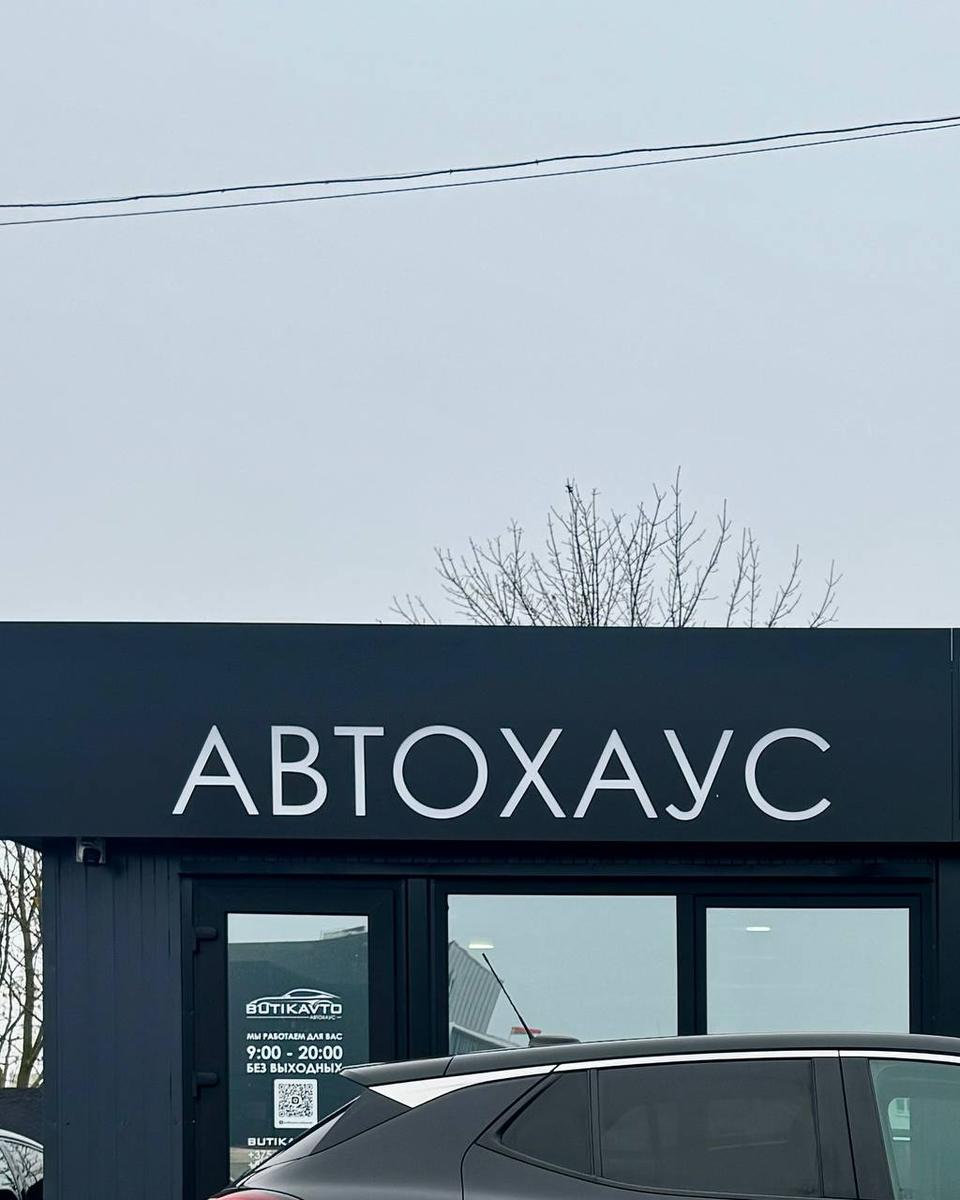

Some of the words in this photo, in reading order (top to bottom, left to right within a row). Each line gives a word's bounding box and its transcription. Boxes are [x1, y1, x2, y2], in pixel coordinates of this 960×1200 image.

[171, 725, 832, 822] АВТОХАУС
[246, 1003, 343, 1015] BUTIKAVTO
[246, 1033, 261, 1041] МЫ
[263, 1033, 306, 1041] РАБОТАЕМ
[307, 1033, 324, 1041] ДЛЯ
[326, 1033, 343, 1041] ВАС
[246, 1045, 282, 1060] 9:00
[298, 1045, 343, 1060] 20:00
[246, 1063, 267, 1074] БЕЗ
[270, 1062, 343, 1075] ВЫХОДНЫХ
